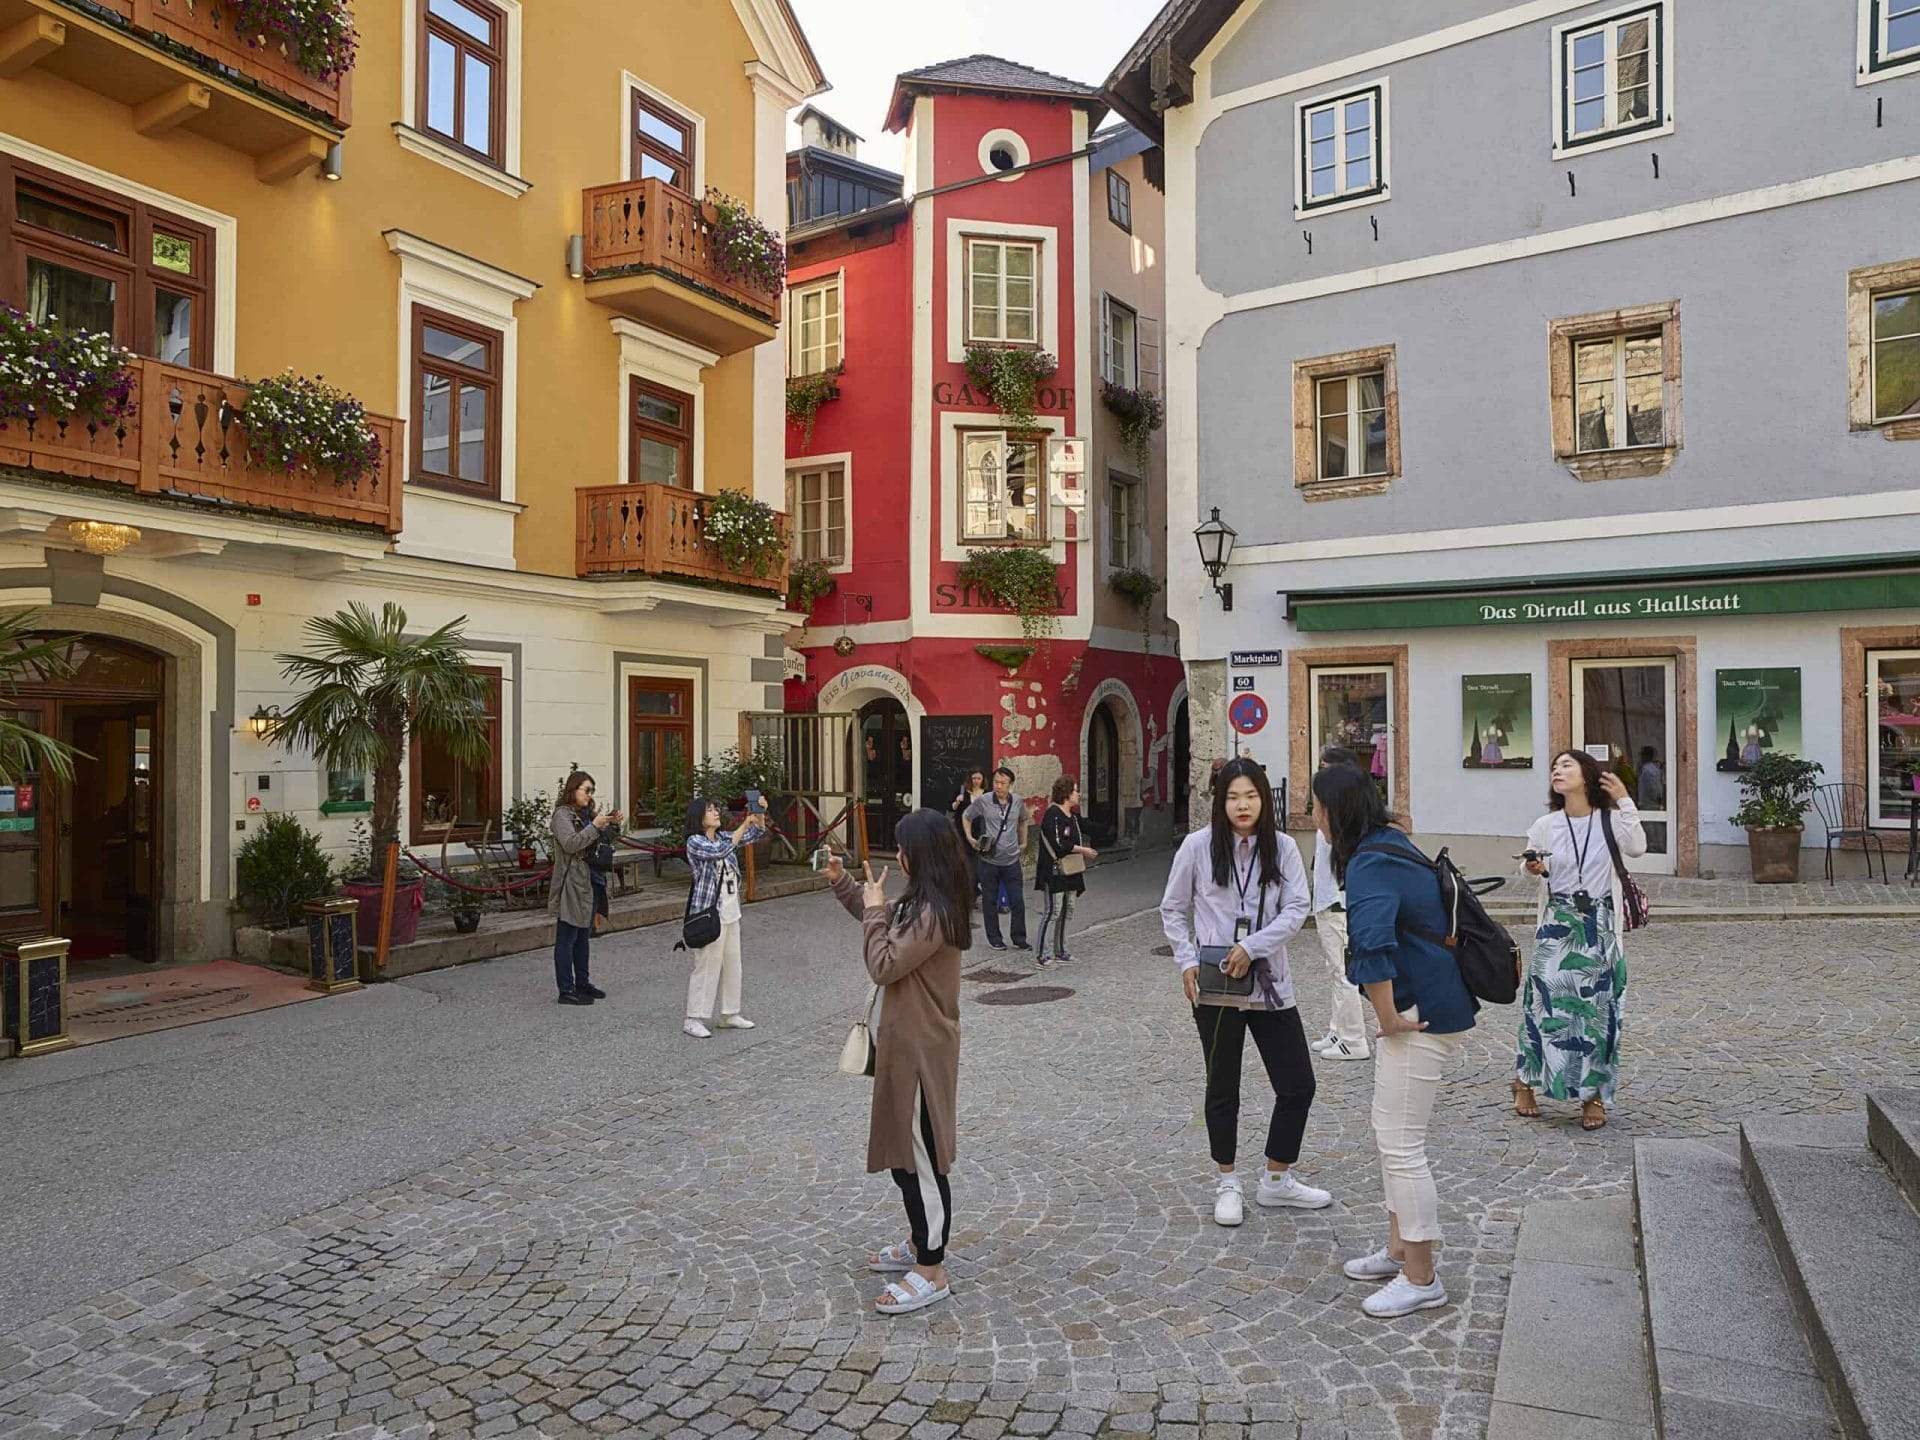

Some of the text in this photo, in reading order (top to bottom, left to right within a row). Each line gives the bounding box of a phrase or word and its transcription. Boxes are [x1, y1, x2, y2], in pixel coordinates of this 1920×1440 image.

[933, 382, 1075, 410] GASOF
[936, 583, 1071, 609] SIMY
[1479, 594, 1742, 620] Das Dirndl aus Hallstatt
[1233, 653, 1278, 665] Marktplatz
[823, 670, 911, 706] EIS Giovanni EIS
[1237, 677, 1250, 687] 60
